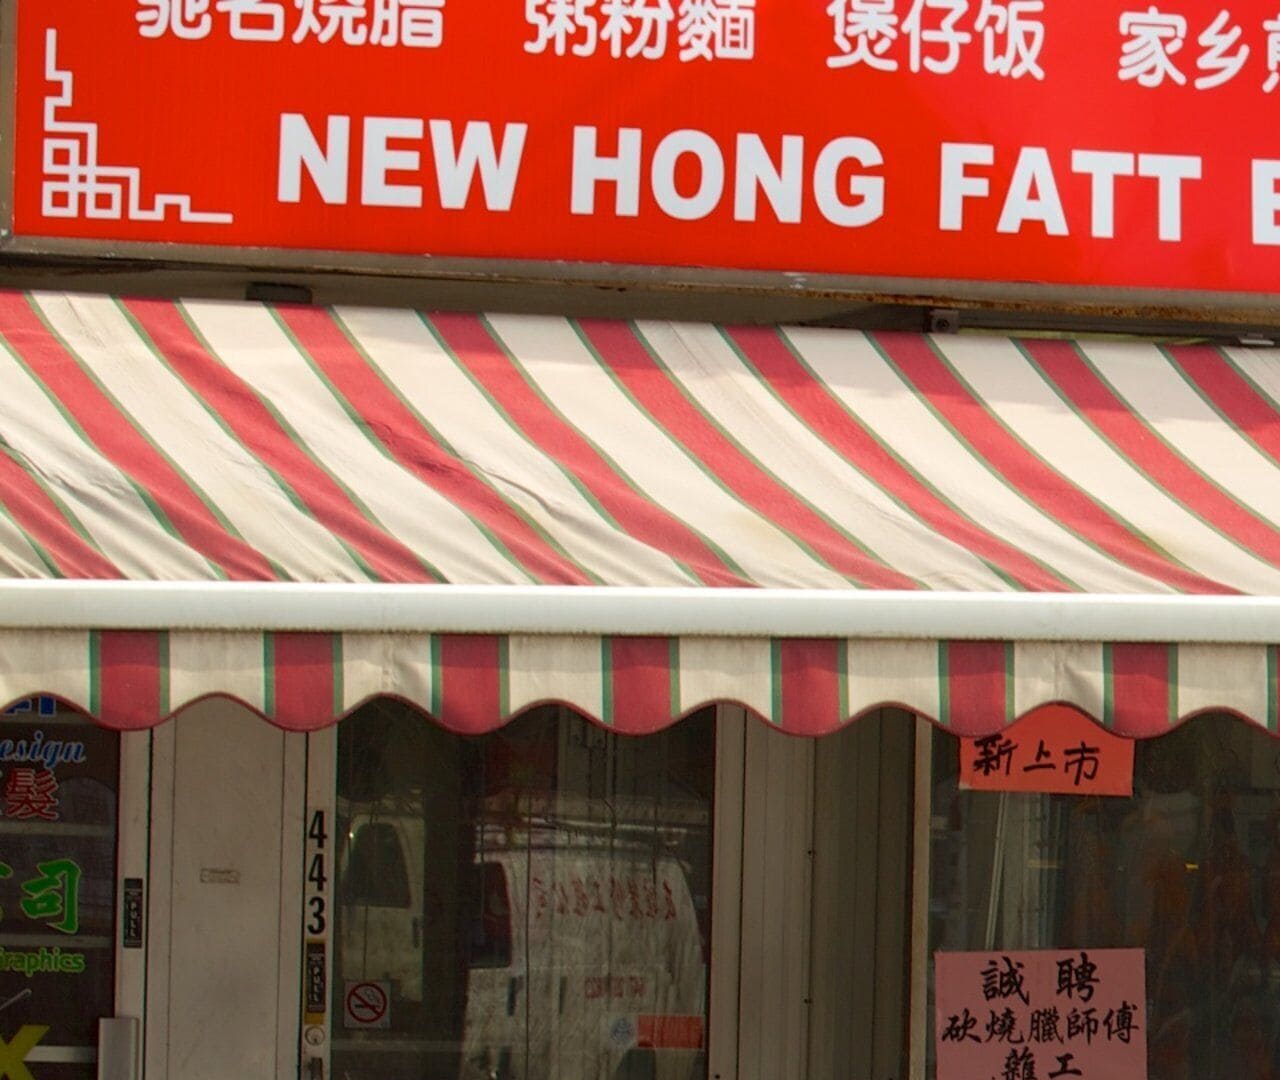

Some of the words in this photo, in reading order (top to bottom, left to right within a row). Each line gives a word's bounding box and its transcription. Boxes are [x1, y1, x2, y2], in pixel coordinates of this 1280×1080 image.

[826, 0, 1046, 81] 煲仔饭
[277, 112, 528, 213] NEW
[570, 125, 887, 229] HONG
[938, 142, 1203, 244] FATT
[973, 734, 1100, 786] 新上市
[20, 859, 82, 935] 司
[307, 811, 328, 934] 443
